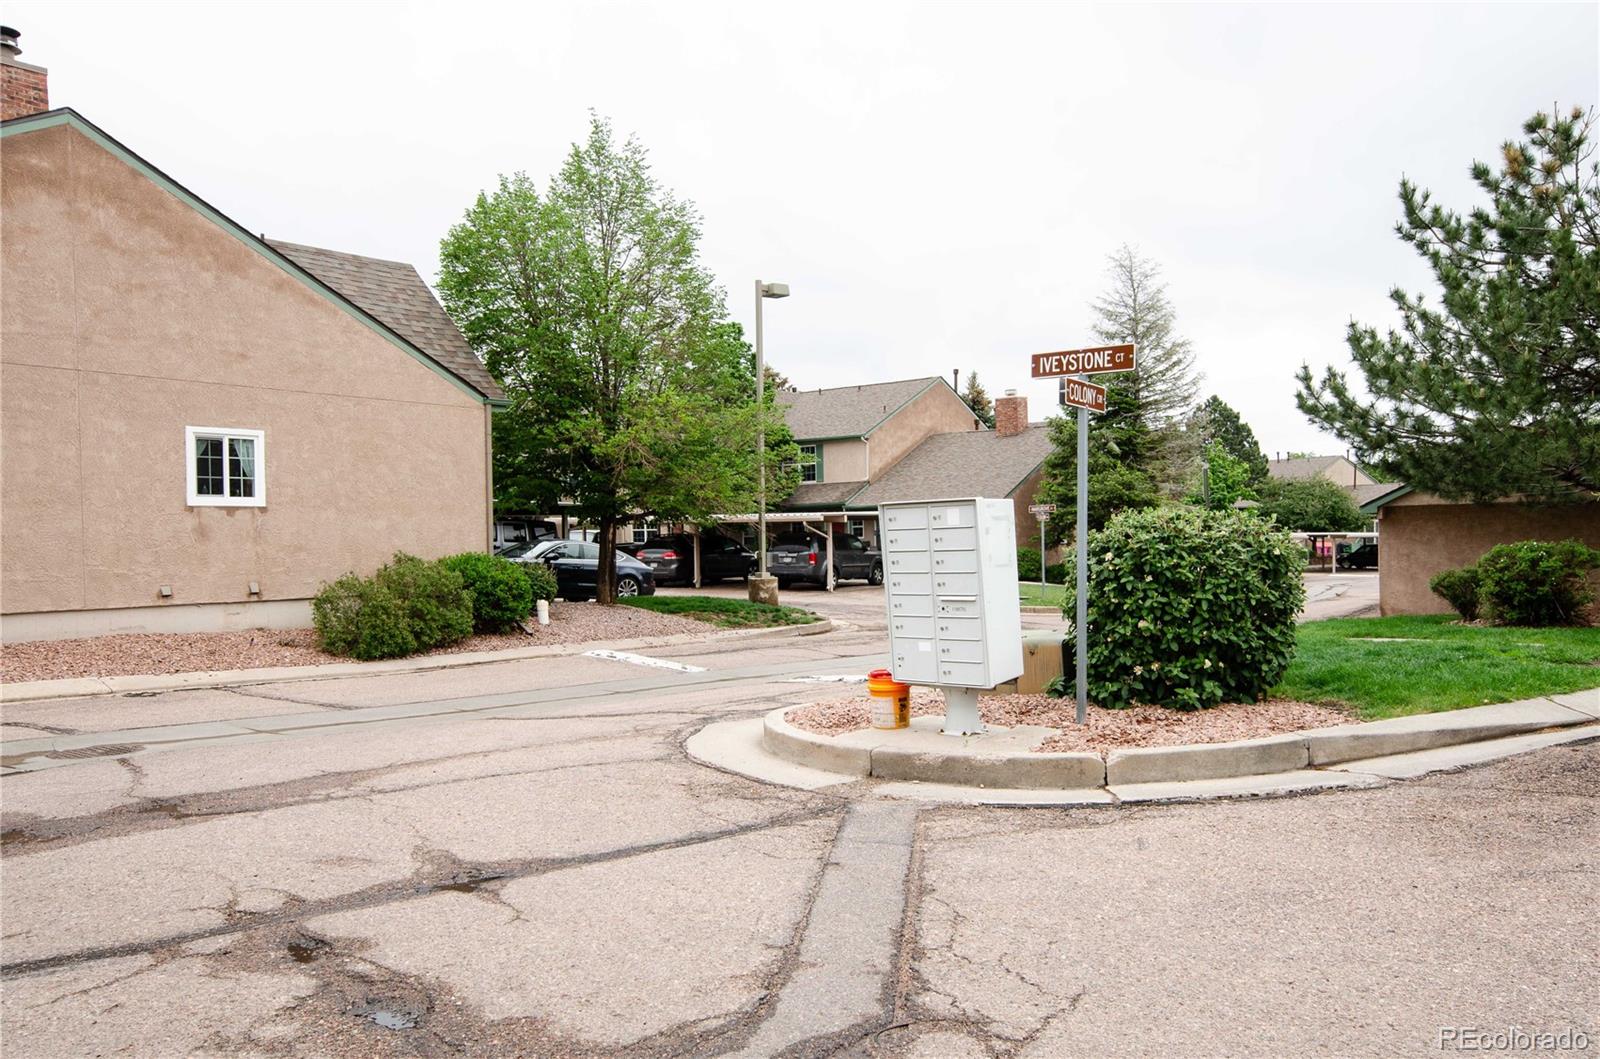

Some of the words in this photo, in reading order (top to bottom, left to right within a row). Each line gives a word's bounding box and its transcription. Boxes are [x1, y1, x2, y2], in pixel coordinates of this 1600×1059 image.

[1040, 350, 1112, 373] IVEYSTONE
[1115, 353, 1125, 362] CT
[1069, 383, 1096, 405] COLONY
